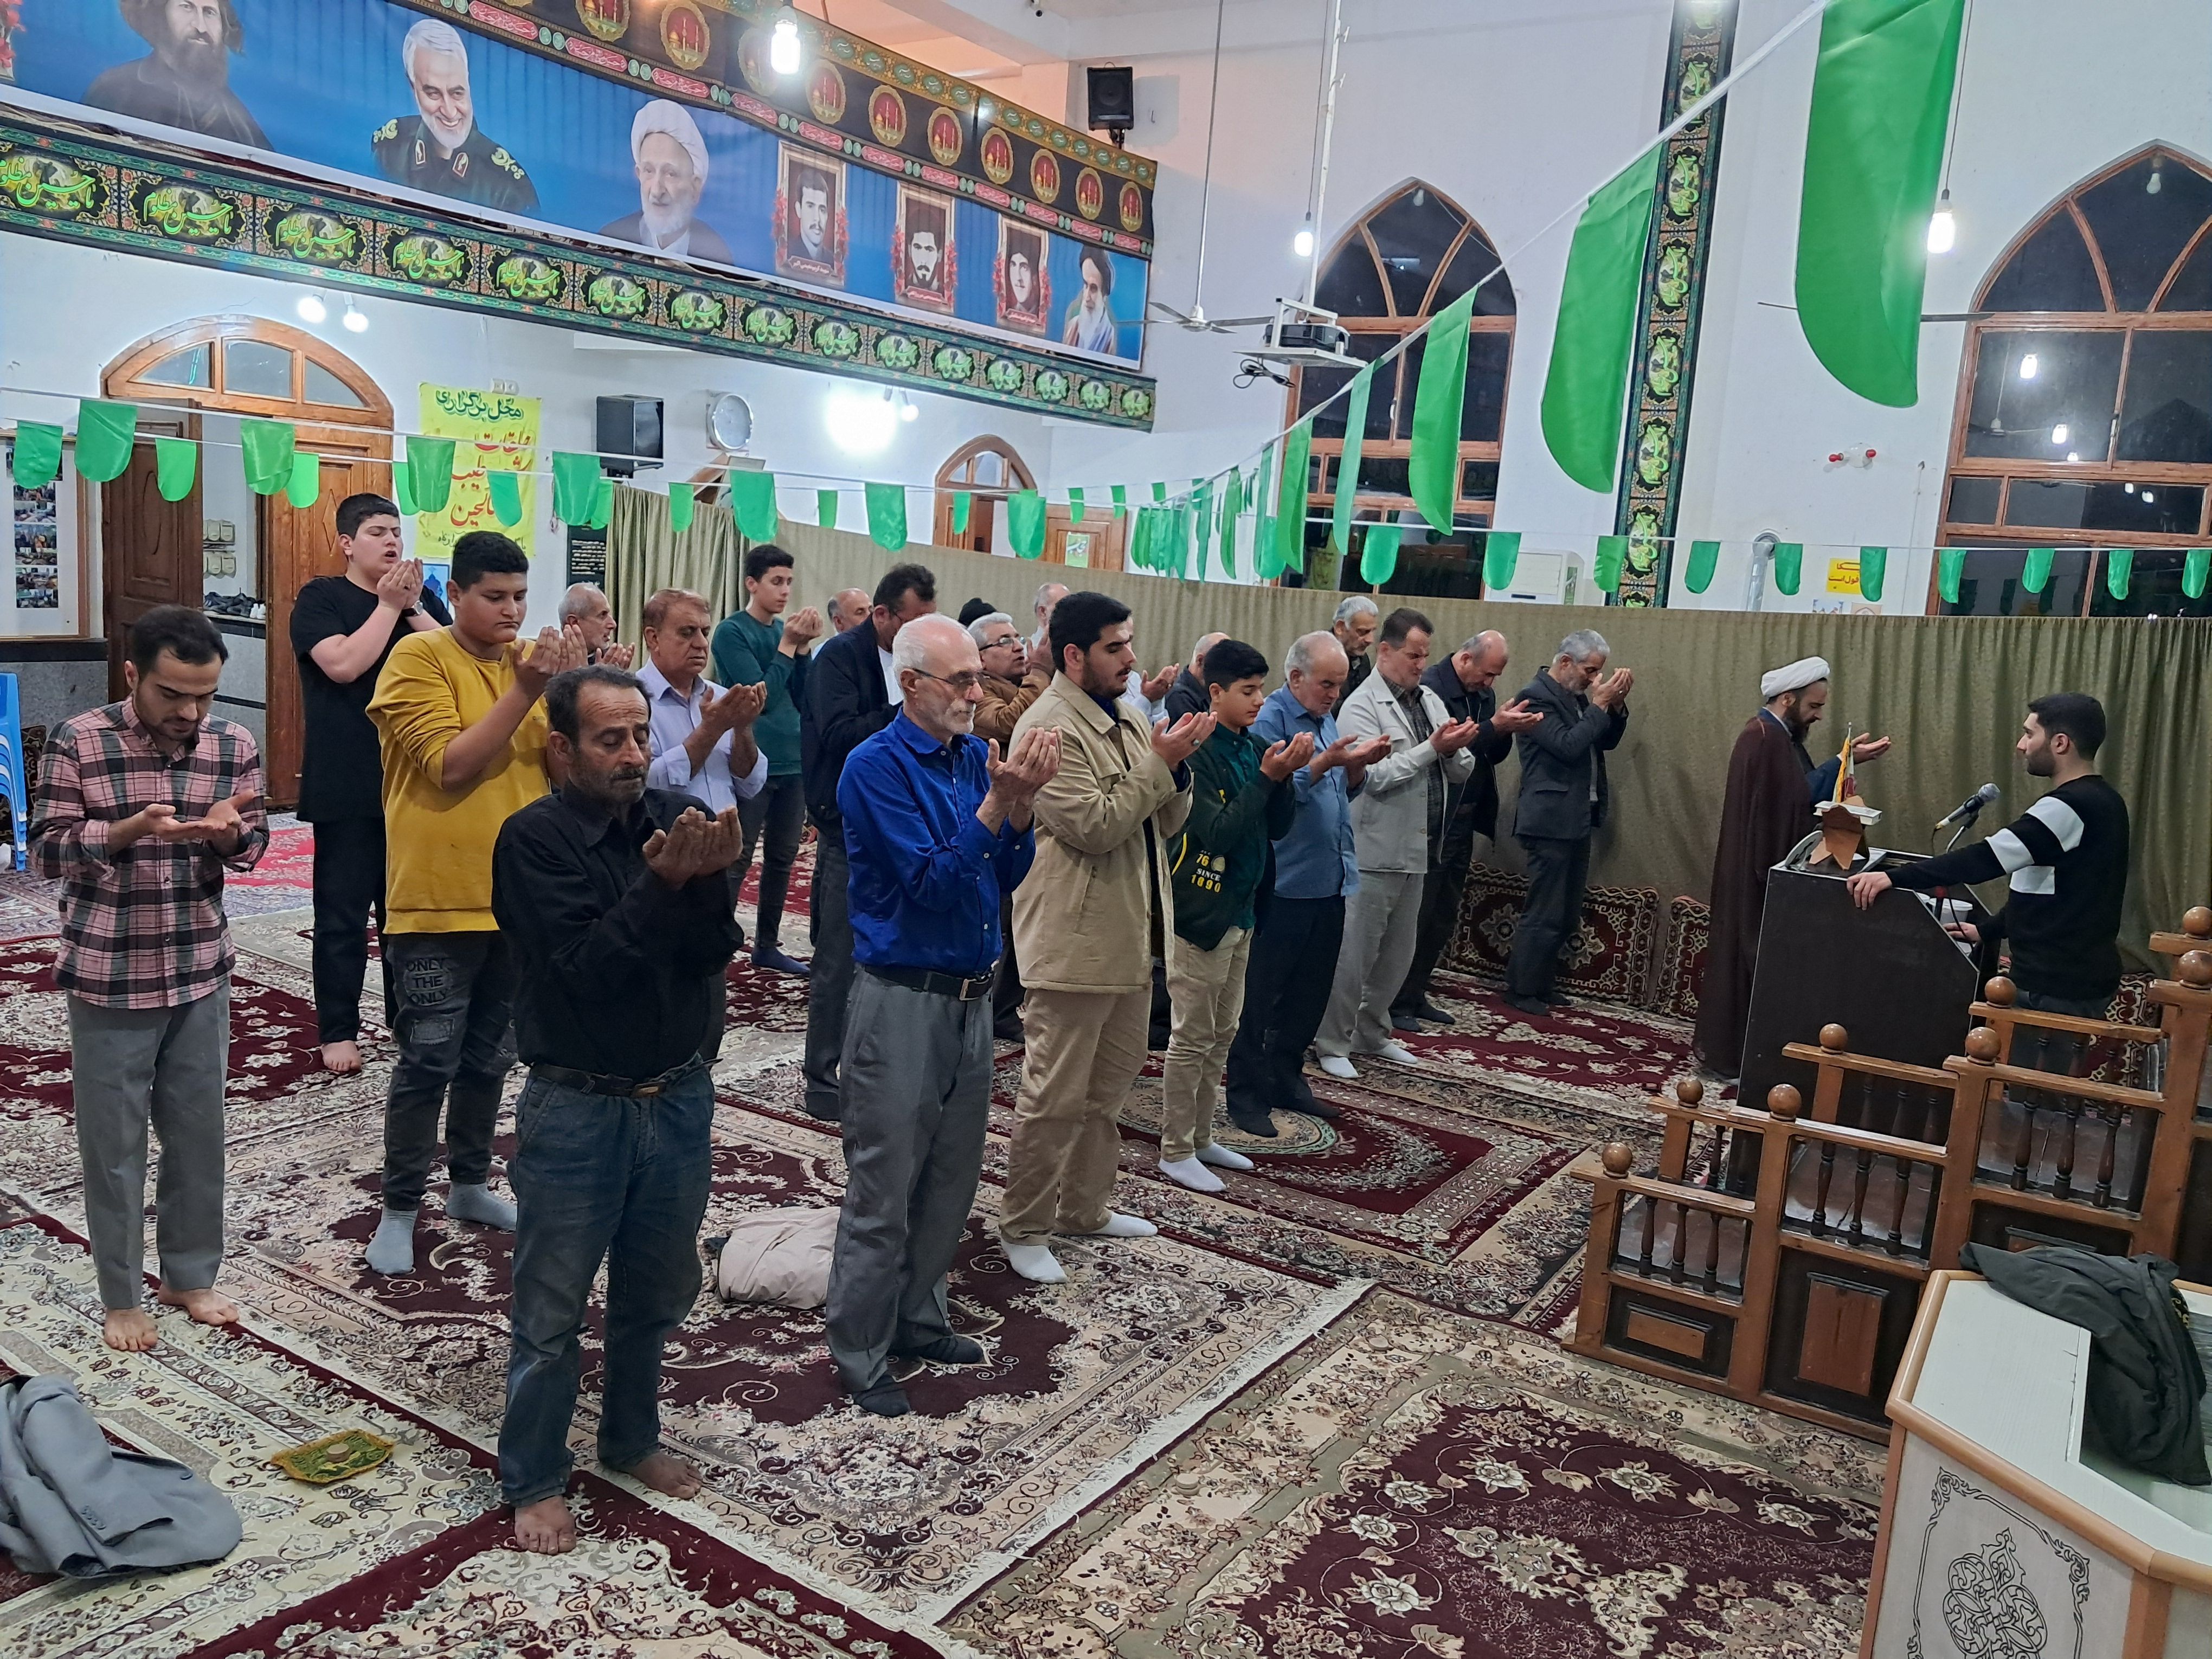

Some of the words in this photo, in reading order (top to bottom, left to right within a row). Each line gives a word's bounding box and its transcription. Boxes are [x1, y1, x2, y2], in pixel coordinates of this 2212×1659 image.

[0, 157, 32, 186] مظلو
[436, 389, 488, 422] برگزاری
[452, 455, 486, 490] طیب
[451, 491, 496, 527] الحین
[1196, 853, 1210, 866] 76
[1196, 868, 1221, 881] SINCE
[413, 975, 443, 988] THE
